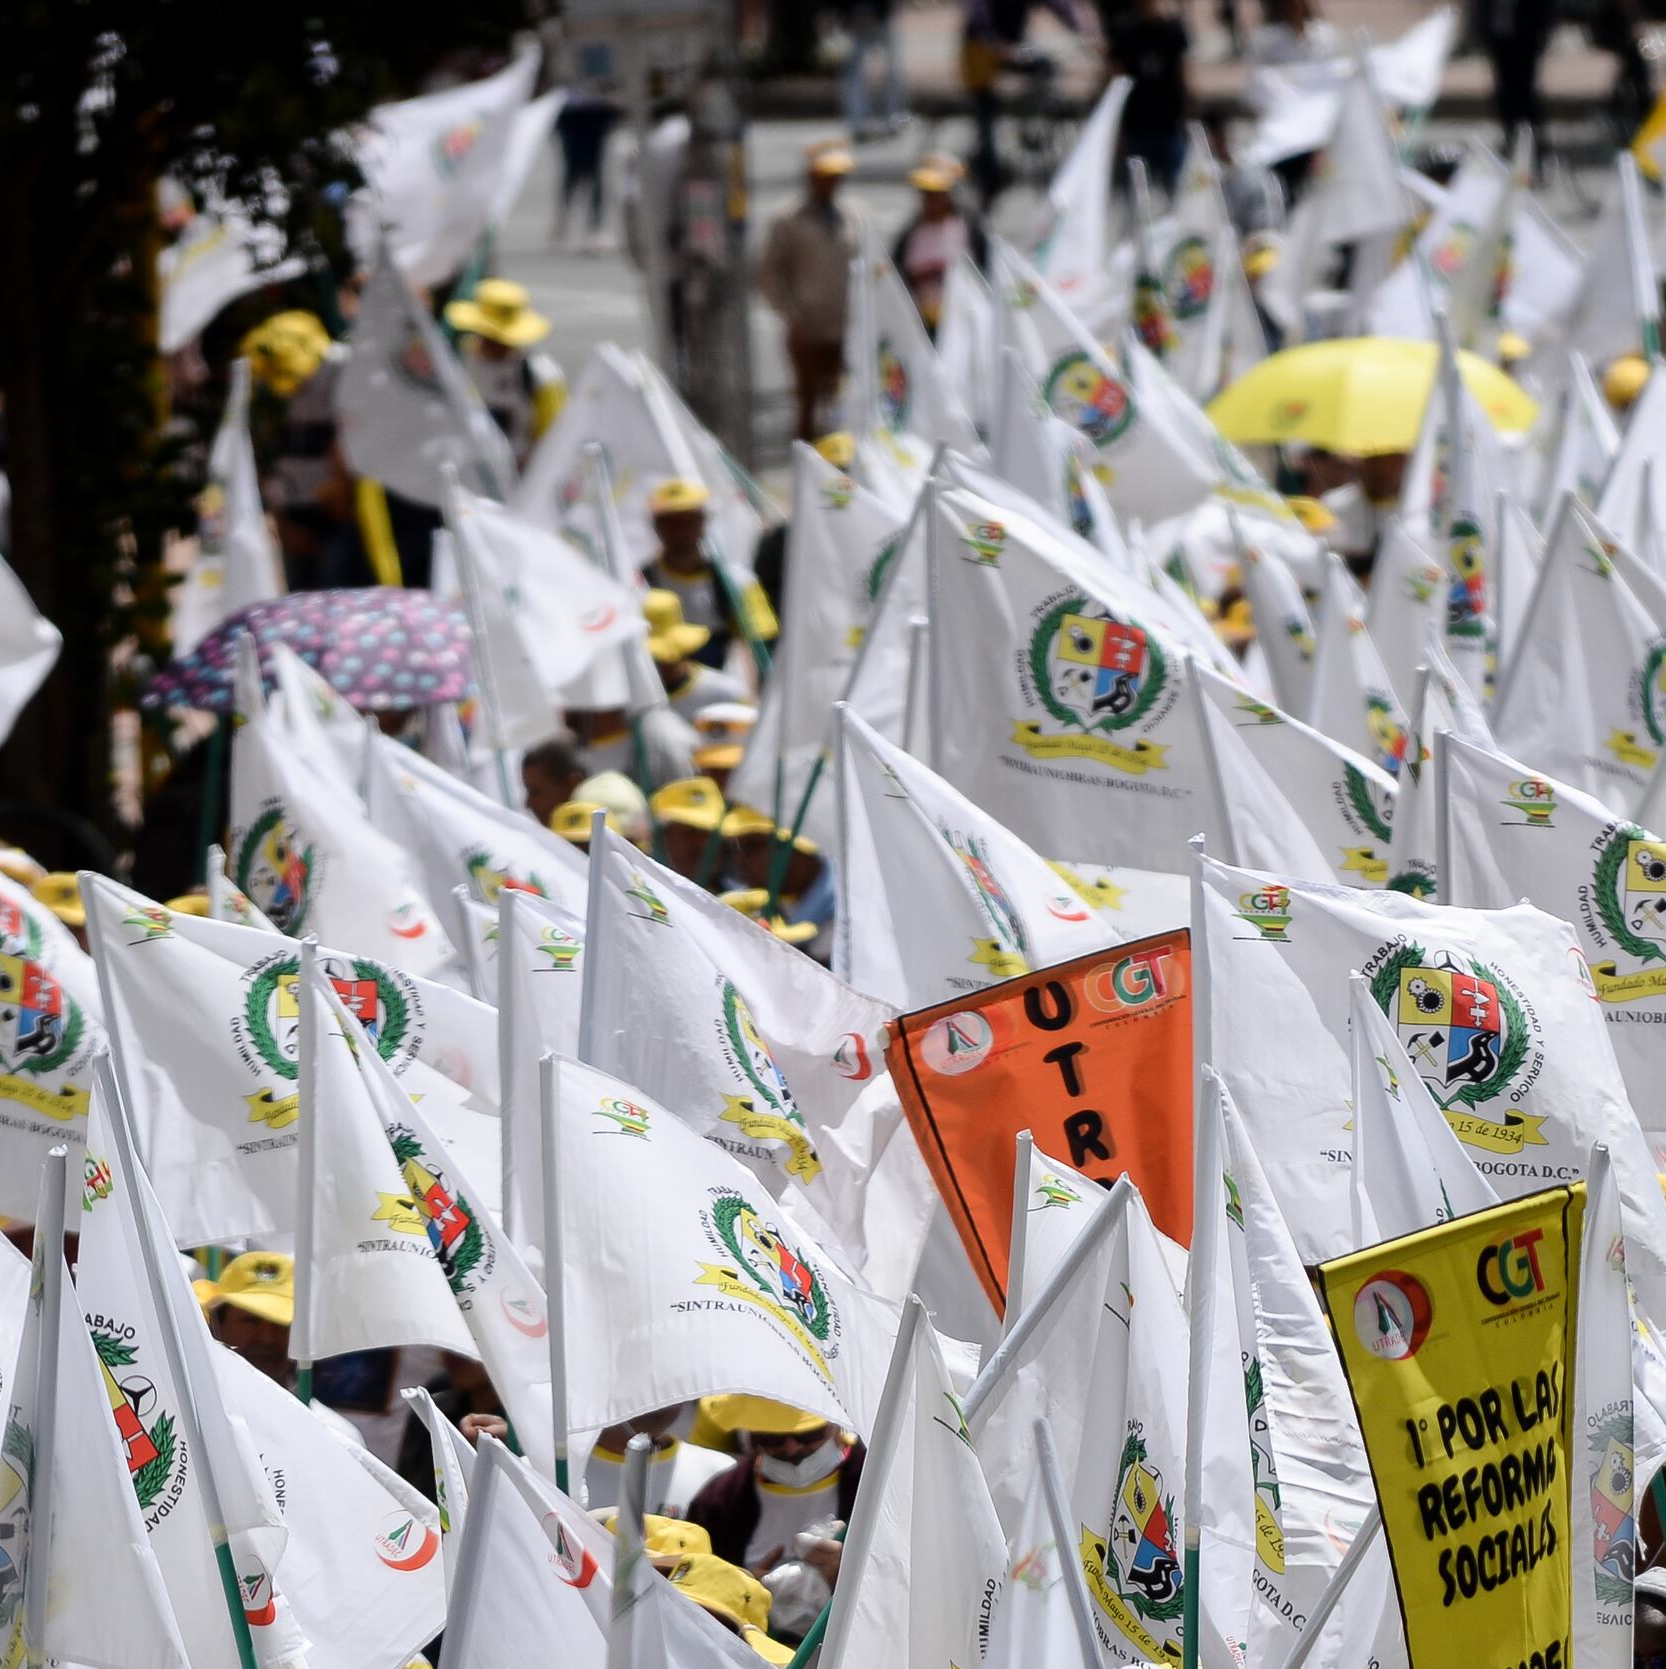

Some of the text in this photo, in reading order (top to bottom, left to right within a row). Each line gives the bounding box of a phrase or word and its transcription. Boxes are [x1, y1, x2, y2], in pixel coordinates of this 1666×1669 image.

[1577, 884, 1607, 949] HUMILDAD
[240, 949, 287, 983] TRABAJO
[1084, 945, 1172, 1013] CGT
[1362, 933, 1407, 978] TRABAJO
[1598, 978, 1644, 996] Fundado
[231, 1016, 263, 1078] HUMILDAD
[715, 1019, 745, 1084] HUMILDAD
[1489, 960, 1545, 1104] HONESTIDAD Y SERVICIO
[1457, 1119, 1523, 1144] 15 de 1934
[1534, 1165, 1580, 1181] D.C.”
[357, 1239, 436, 1260] “SINTRAUNIO
[701, 1210, 728, 1259] HUMILDAD
[720, 1281, 761, 1305] Fundado
[1477, 1228, 1546, 1308] CGT
[1439, 1401, 1504, 1457] POR
[1512, 1360, 1562, 1429] LAS
[146, 1440, 188, 1533] HONESTIDAD
[1417, 1434, 1557, 1542] REFORMA
[1438, 1517, 1557, 1608] SOCIALES
[1100, 1580, 1152, 1650] Mayo 15 de
